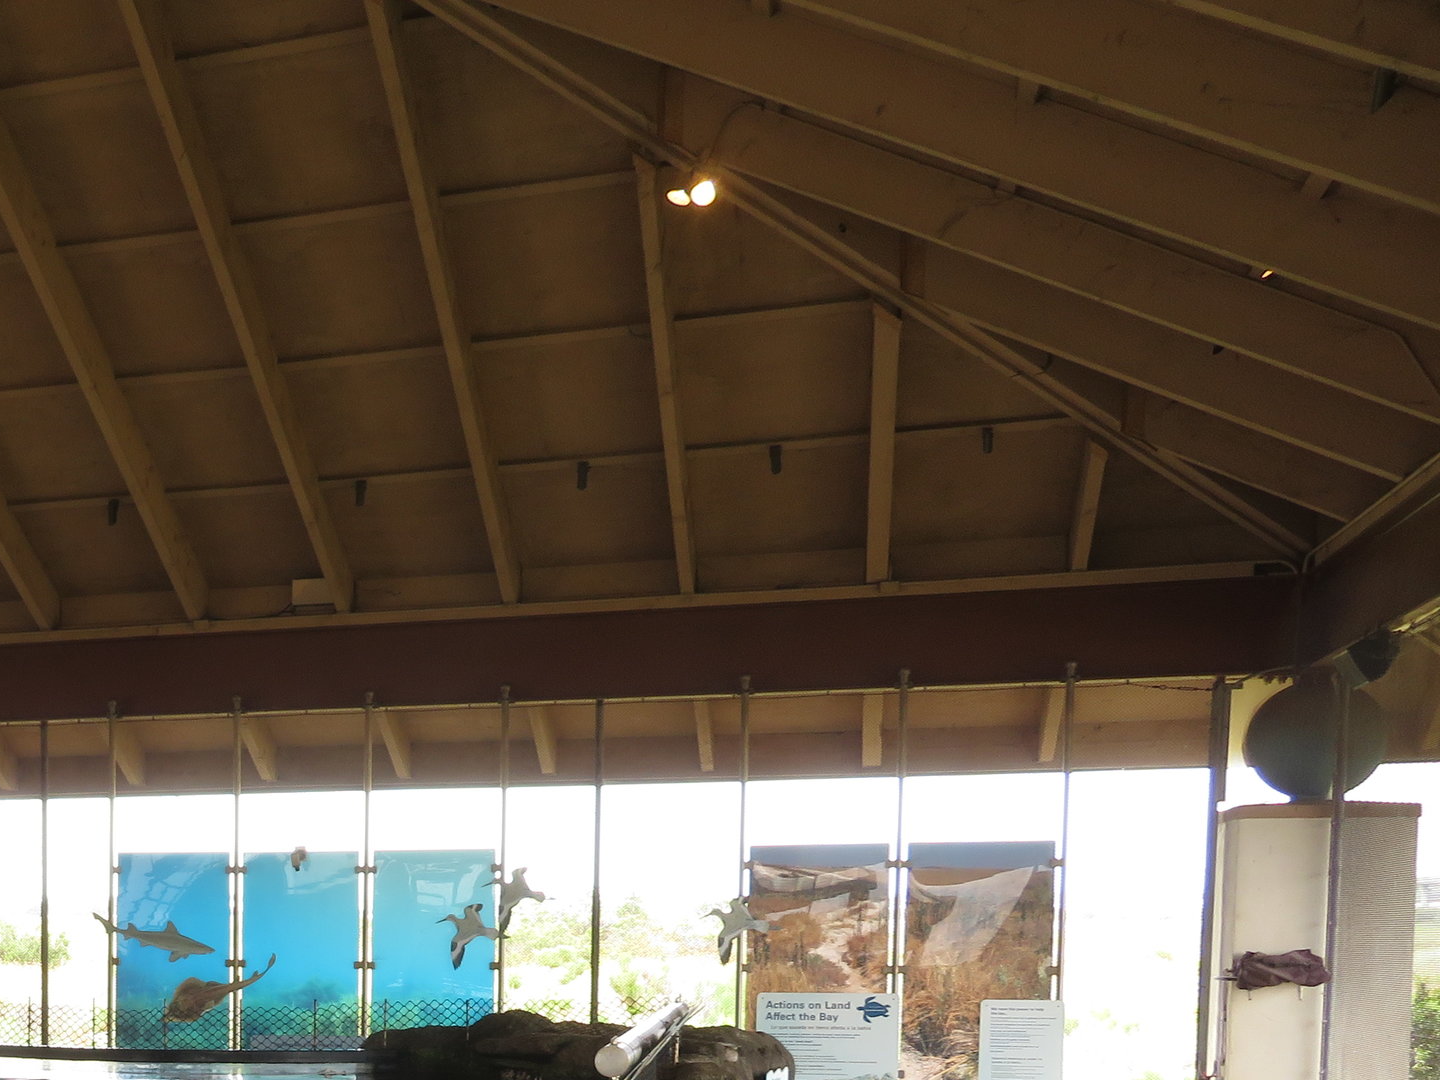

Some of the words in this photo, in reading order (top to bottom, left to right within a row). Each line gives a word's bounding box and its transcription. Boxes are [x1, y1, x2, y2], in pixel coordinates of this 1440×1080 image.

[765, 1000, 806, 1010] Actions
[807, 1002, 822, 1010] on
[824, 1001, 852, 1010] Land
[765, 1012, 796, 1021] Affect
[798, 1012, 817, 1021] the
[819, 1012, 840, 1023] Bay
